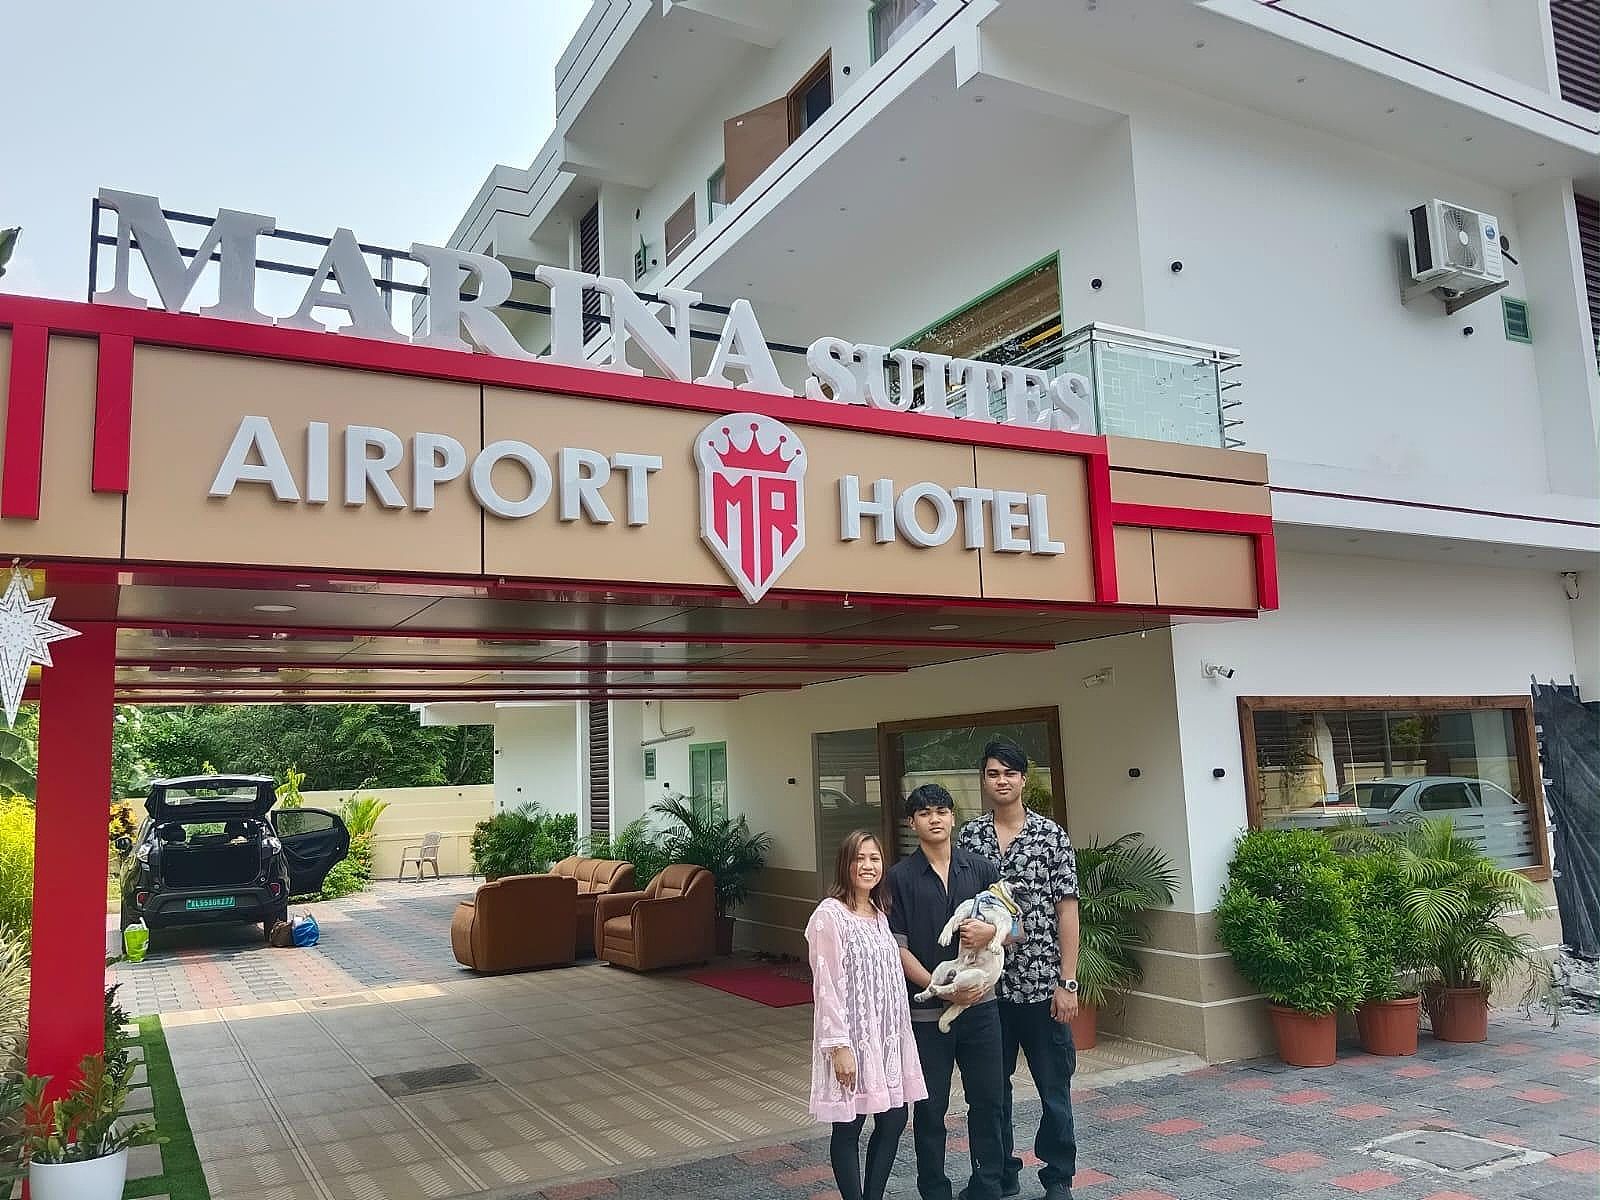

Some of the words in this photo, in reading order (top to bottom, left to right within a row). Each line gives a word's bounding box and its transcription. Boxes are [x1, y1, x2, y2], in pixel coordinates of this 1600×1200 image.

[95, 187, 794, 397] MARINA
[806, 337, 1092, 433] SUITES
[209, 415, 663, 527] AIRPORT
[839, 474, 1066, 556] HOTEL
[712, 472, 799, 586] MR
